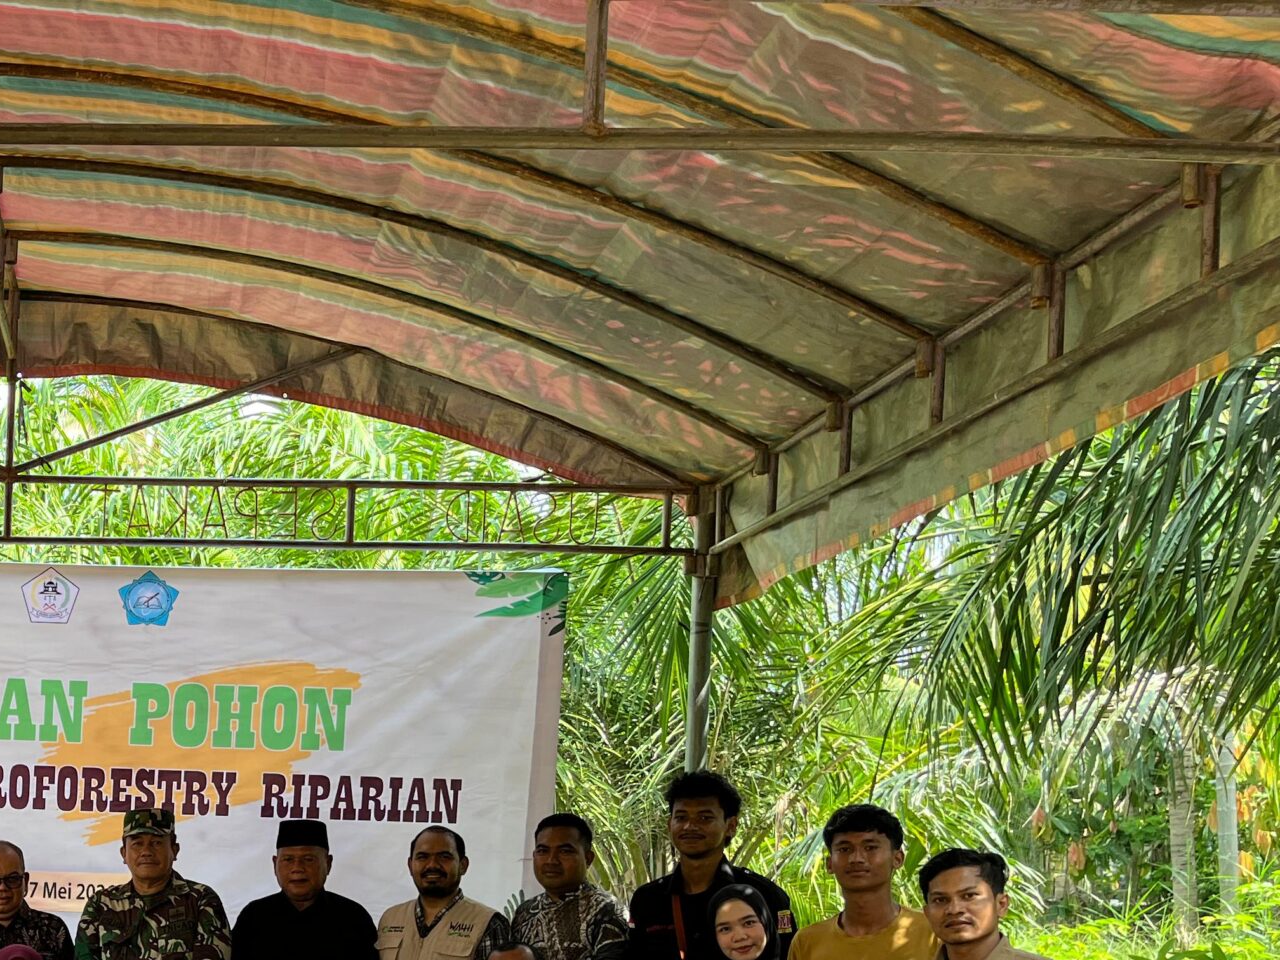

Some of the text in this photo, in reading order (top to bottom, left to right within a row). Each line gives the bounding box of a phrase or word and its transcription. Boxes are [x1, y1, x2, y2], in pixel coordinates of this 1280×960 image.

[128, 682, 353, 751] POHON
[260, 772, 463, 824] RIPARIAN
[24, 882, 39, 899] 7
[43, 881, 72, 900] Mei
